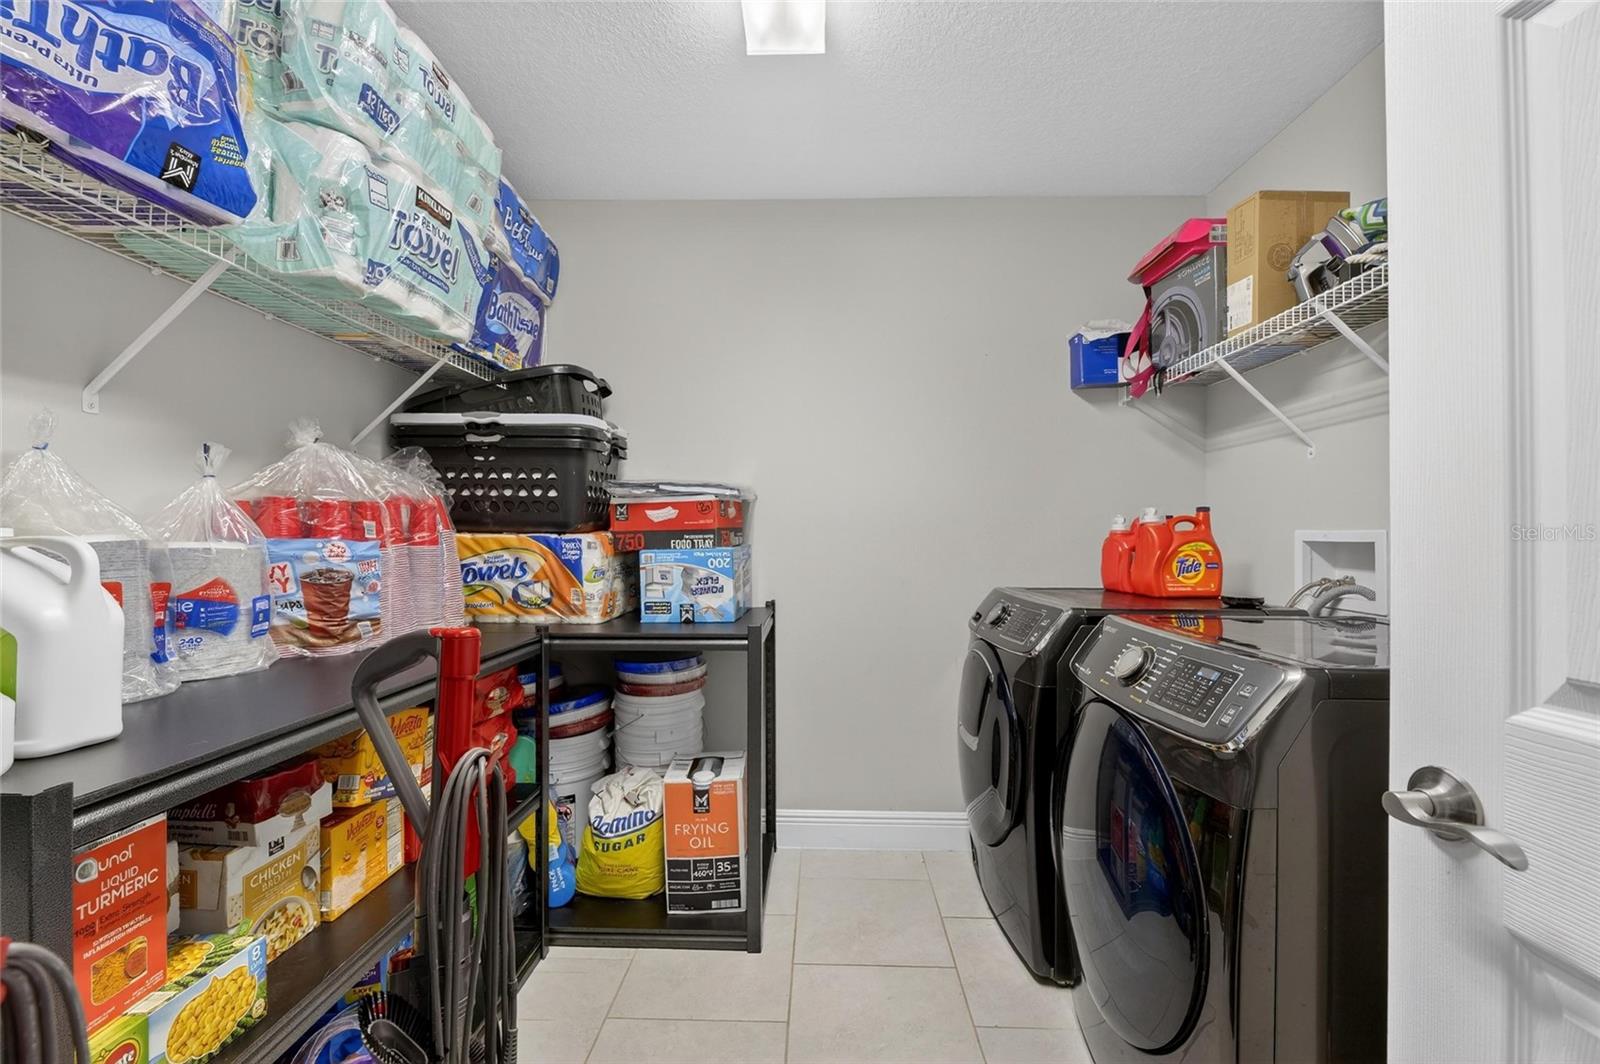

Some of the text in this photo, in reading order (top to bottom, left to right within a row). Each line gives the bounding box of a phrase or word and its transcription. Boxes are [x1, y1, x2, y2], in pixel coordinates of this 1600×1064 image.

[53, 53, 98, 88] Ultra
[418, 64, 455, 122] Towel
[390, 210, 459, 284] Towel
[616, 534, 645, 550] 750
[671, 539, 714, 549] FOOD TRAY
[708, 558, 731, 569] 200
[1175, 557, 1202, 578] Tide
[696, 576, 720, 587] FLEX
[691, 585, 725, 597] POWER
[592, 810, 656, 836] Domino
[674, 822, 729, 836] FRYING
[594, 834, 645, 853] SUGAR
[689, 837, 715, 849] OIL
[250, 851, 301, 888] CHICKEN
[716, 861, 731, 873] 35
[101, 866, 139, 892] LIQUID
[76, 868, 159, 920] TURMERIC
[252, 945, 261, 961] 8
